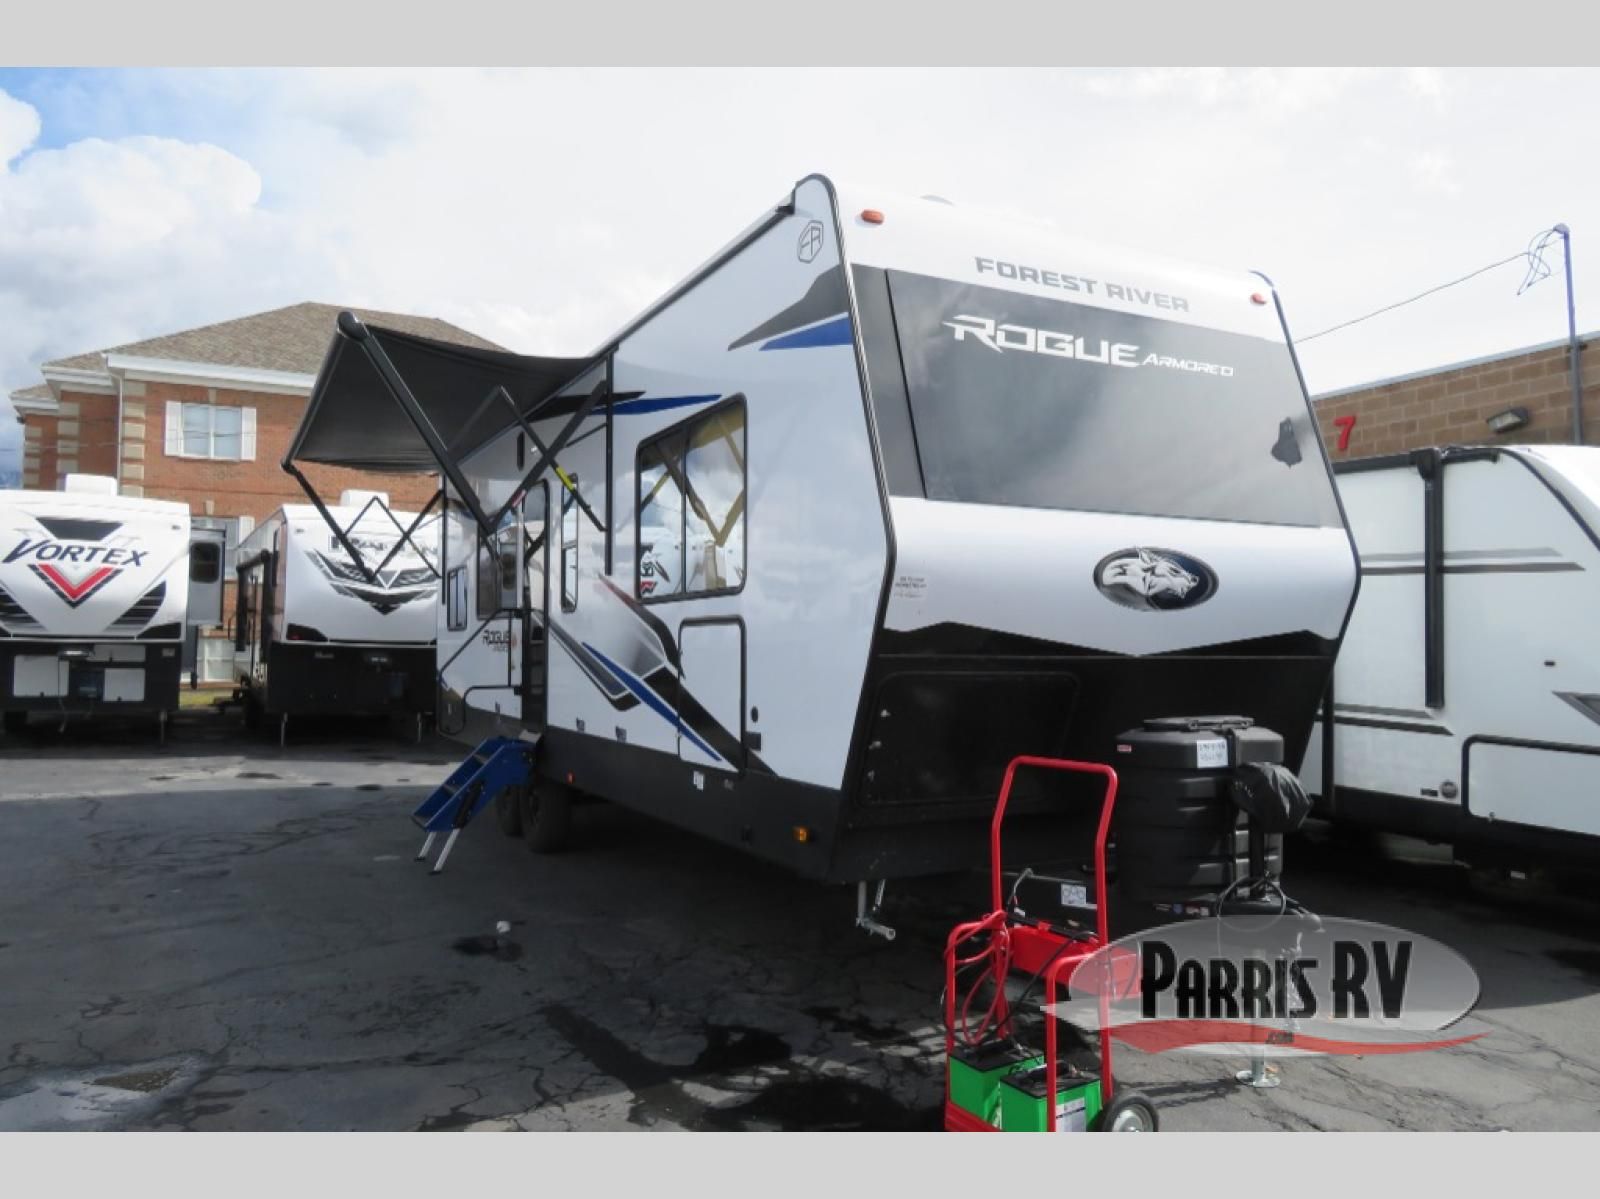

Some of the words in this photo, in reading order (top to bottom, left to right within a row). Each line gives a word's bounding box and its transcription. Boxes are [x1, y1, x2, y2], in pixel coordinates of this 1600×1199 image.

[974, 256, 1097, 294] FOREST
[1105, 282, 1190, 312] RIVER
[942, 314, 1142, 368] ROGUE
[1141, 353, 1234, 377] ARMORED
[1333, 415, 1356, 451] 7
[2, 538, 149, 567] VORTEX
